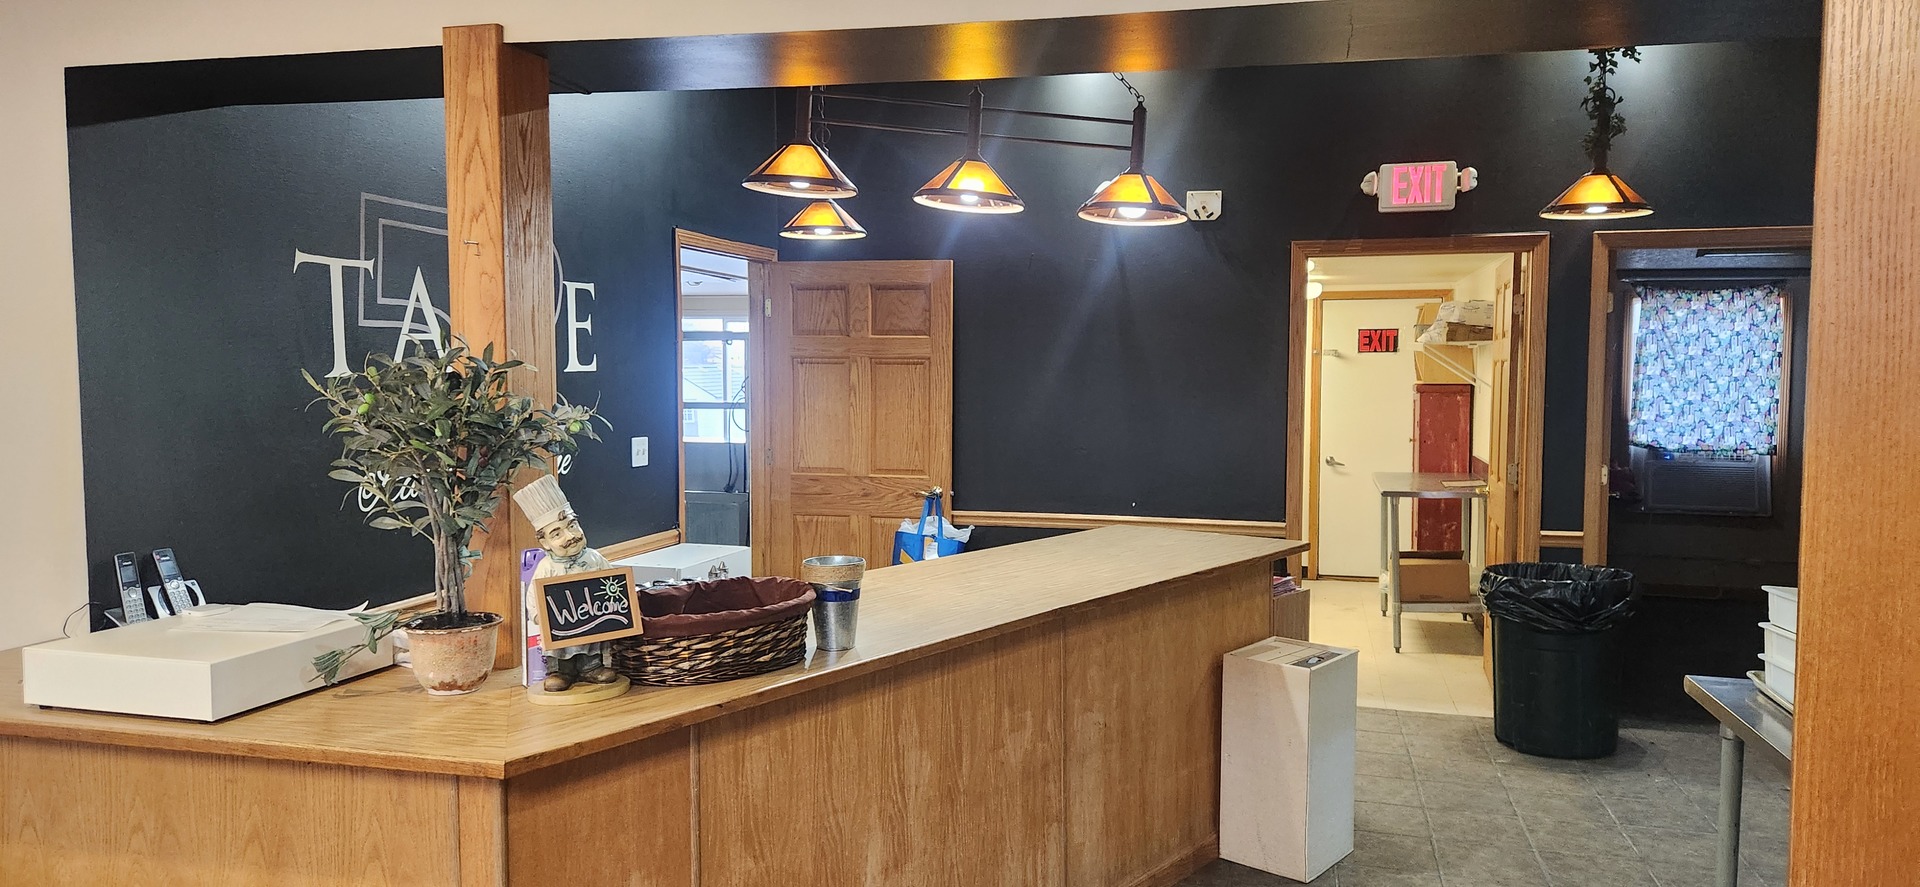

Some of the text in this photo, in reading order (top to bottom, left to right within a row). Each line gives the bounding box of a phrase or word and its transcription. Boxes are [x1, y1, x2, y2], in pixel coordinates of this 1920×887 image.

[1392, 164, 1447, 204] EXIT
[1359, 330, 1398, 352] EXIT
[546, 586, 629, 625] Welcome
